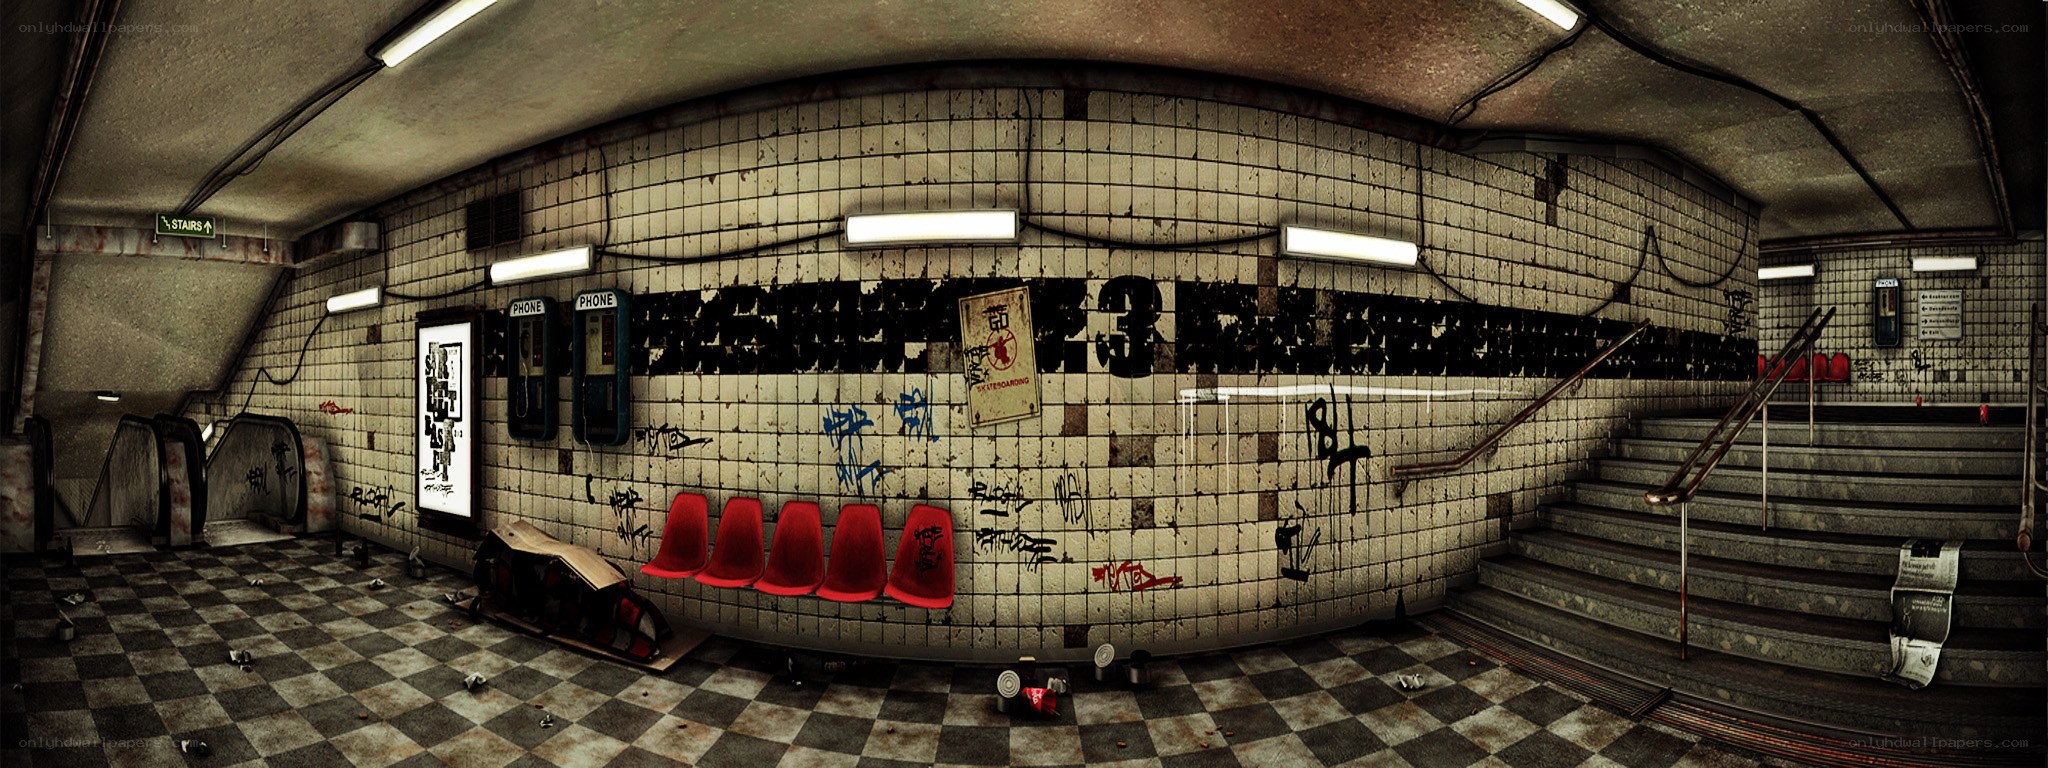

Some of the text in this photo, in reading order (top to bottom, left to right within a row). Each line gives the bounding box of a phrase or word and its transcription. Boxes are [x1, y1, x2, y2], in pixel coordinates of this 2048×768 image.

[171, 218, 203, 232] STAIRS
[512, 300, 542, 315] PHONE
[579, 293, 613, 308] PHONE
[976, 377, 1030, 392] SKATEBOARDING
